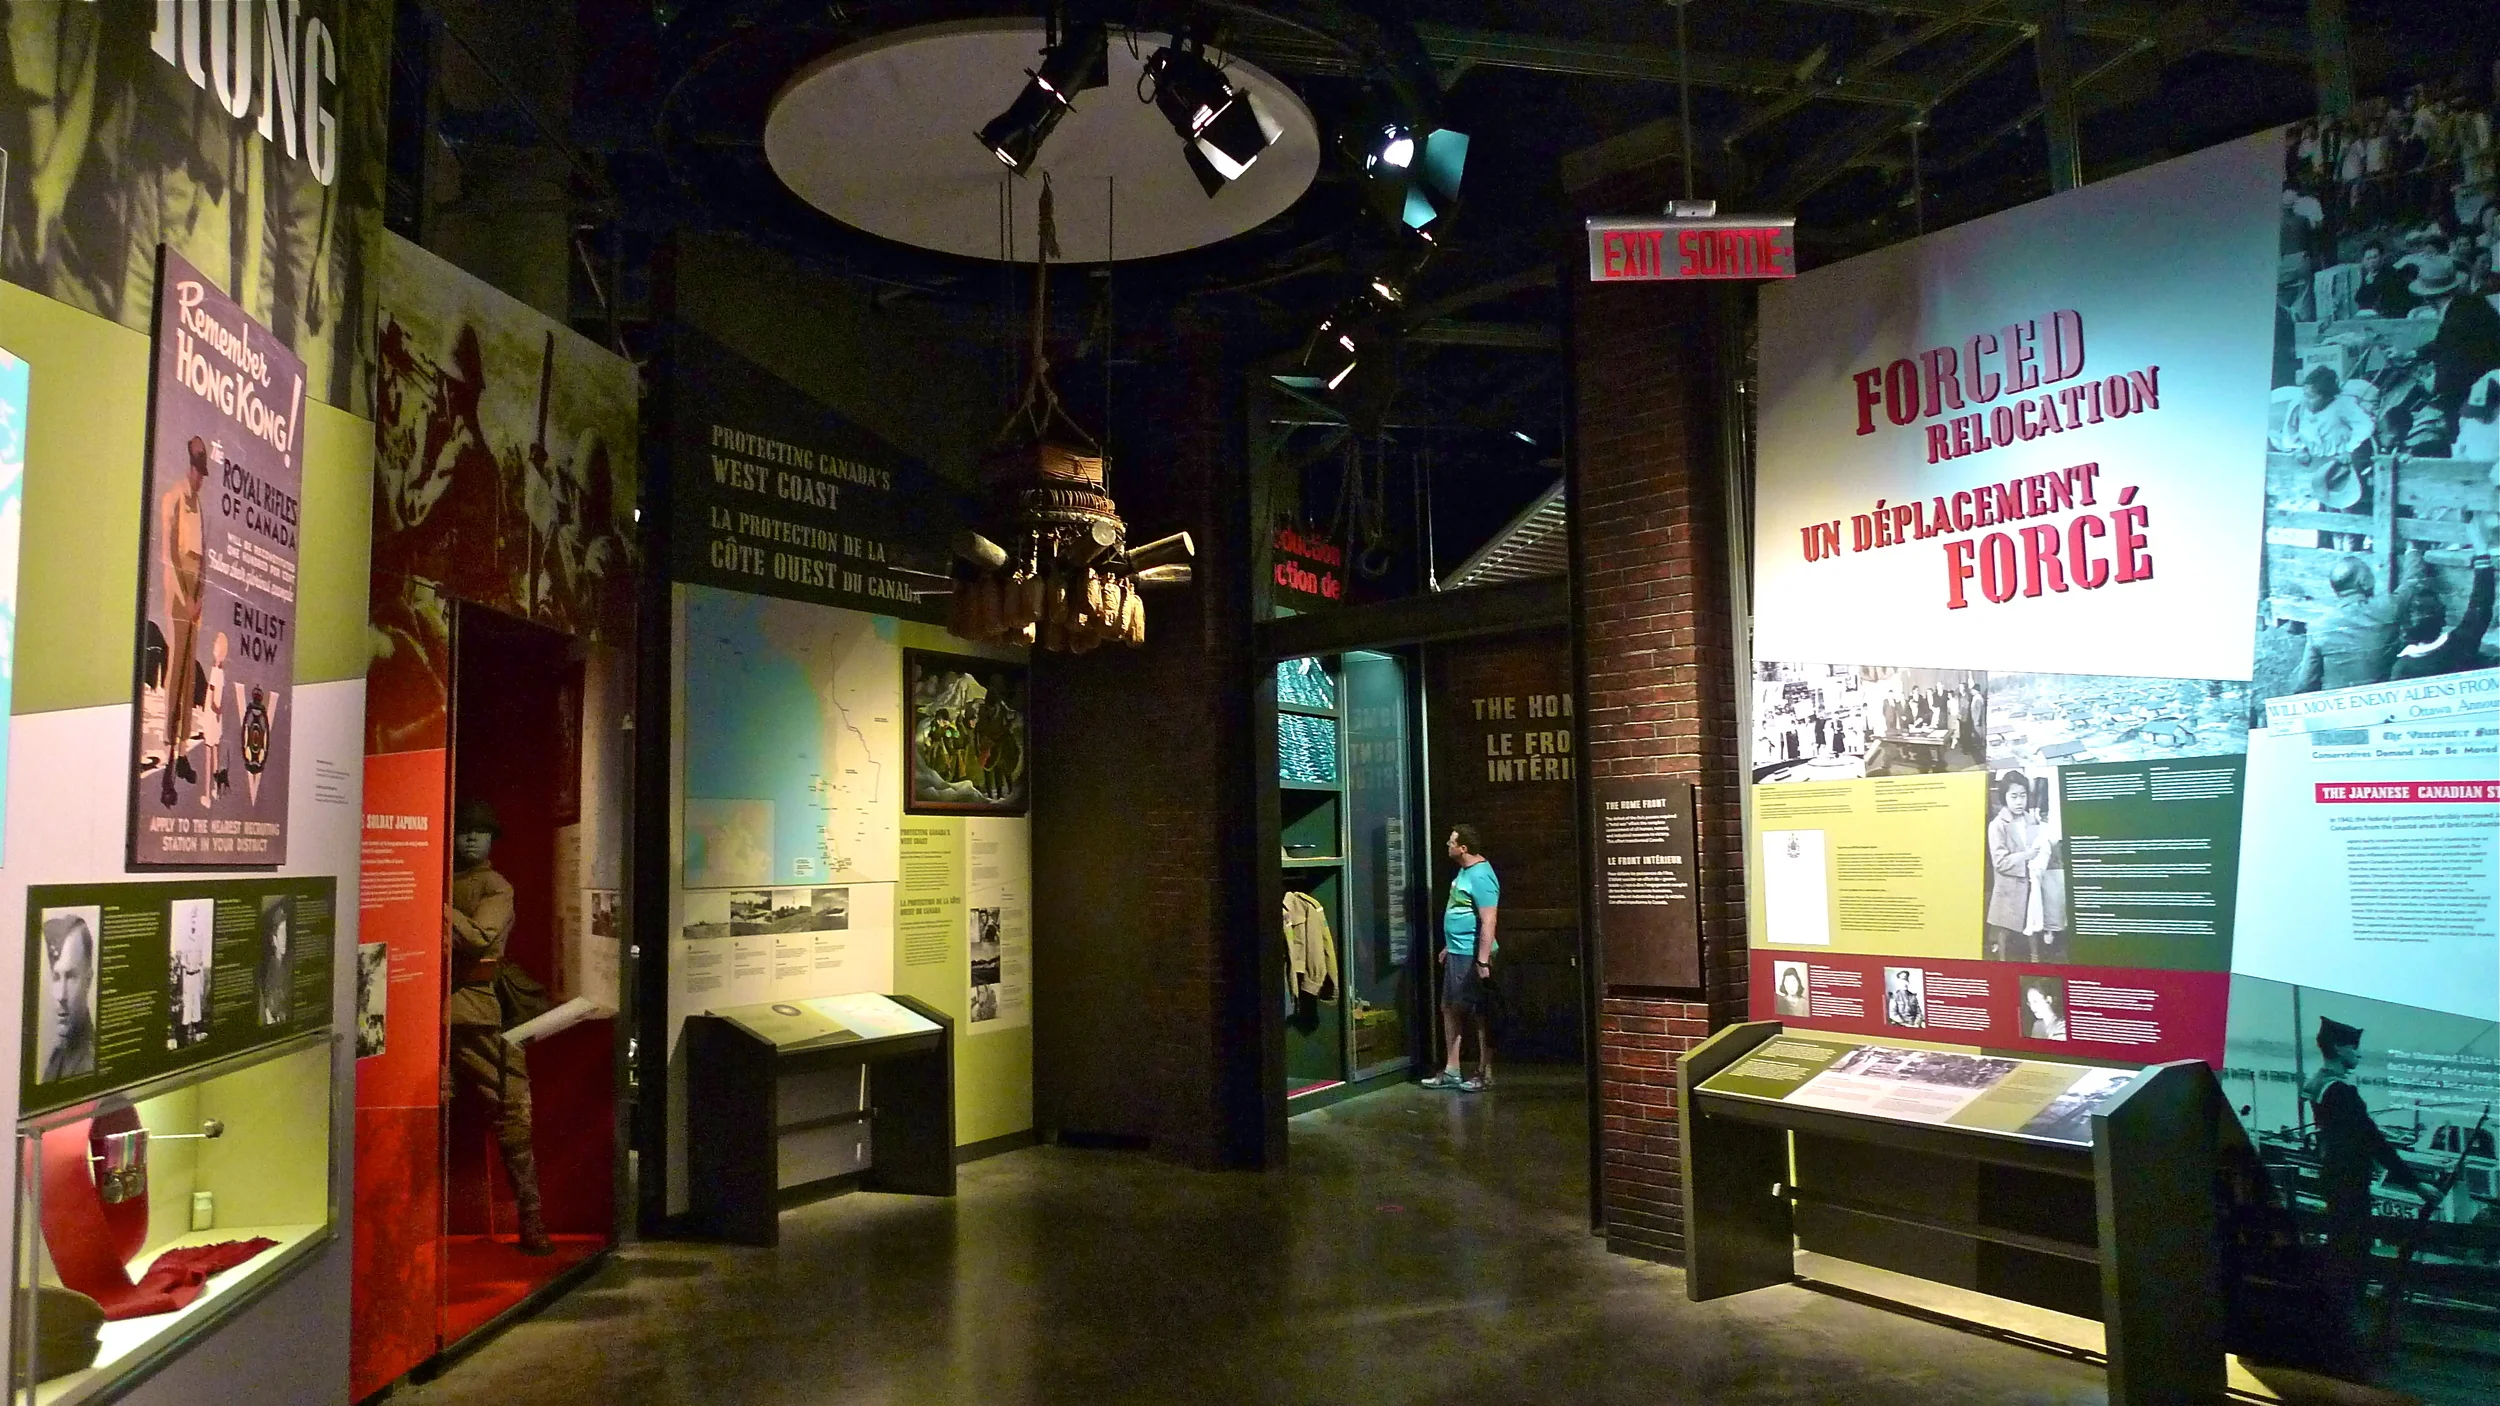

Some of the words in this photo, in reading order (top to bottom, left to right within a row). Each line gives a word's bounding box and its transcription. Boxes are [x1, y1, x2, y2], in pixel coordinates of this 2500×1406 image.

[1603, 231, 1665, 278] EXIT
[1679, 228, 1784, 276] SORTIE
[176, 280, 271, 388] Remember
[1852, 308, 2086, 436] FORCED
[176, 327, 235, 415] HONG
[236, 373, 302, 469] KONG!
[1925, 365, 2160, 464] RELOCATION
[222, 457, 261, 507] ROYAL
[710, 454, 769, 494] WEST
[777, 471, 840, 511] COAST
[711, 424, 814, 472] PROTECTING
[819, 453, 891, 491] CANADA'S
[221, 493, 241, 520] OF
[245, 506, 296, 551] CANADA
[710, 506, 733, 531] LA
[739, 511, 838, 553] PROTECTION
[843, 534, 862, 558] DE
[868, 541, 886, 563] LA
[1800, 520, 1841, 563] UN
[1851, 462, 2099, 552] DÉPLACEMENT
[711, 536, 765, 576] CÔTE
[774, 552, 838, 589] OUEST
[843, 571, 862, 594] DU
[1943, 486, 2154, 609] FORCÉ
[1321, 571, 1340, 600] de
[233, 601, 286, 641] ENLIST
[240, 633, 278, 665] NOW
[1472, 697, 1516, 720] THE
[2268, 704, 2302, 717] WILL
[2304, 698, 2347, 713] MOVE
[2350, 689, 2400, 708] ENEMY
[2404, 683, 2456, 701] ALIENS
[1487, 733, 1513, 756] LE
[1525, 729, 1570, 755] FRO
[1605, 801, 1619, 810] THE
[1620, 800, 1641, 809] HOME
[1642, 798, 1667, 809] FRONT
[2322, 787, 2346, 799] THE
[2349, 786, 2410, 799] JAPANESE
[2418, 785, 2483, 799] CANADIAN
[149, 816, 175, 832] APPLY
[178, 818, 190, 833] TO
[192, 819, 208, 834] THE
[211, 820, 241, 834] NEAREST
[162, 836, 198, 852] STATION
[200, 837, 210, 852] IN
[212, 837, 234, 852] YOUR
[1607, 857, 1617, 865] LE
[1618, 856, 1641, 865] FRONT
